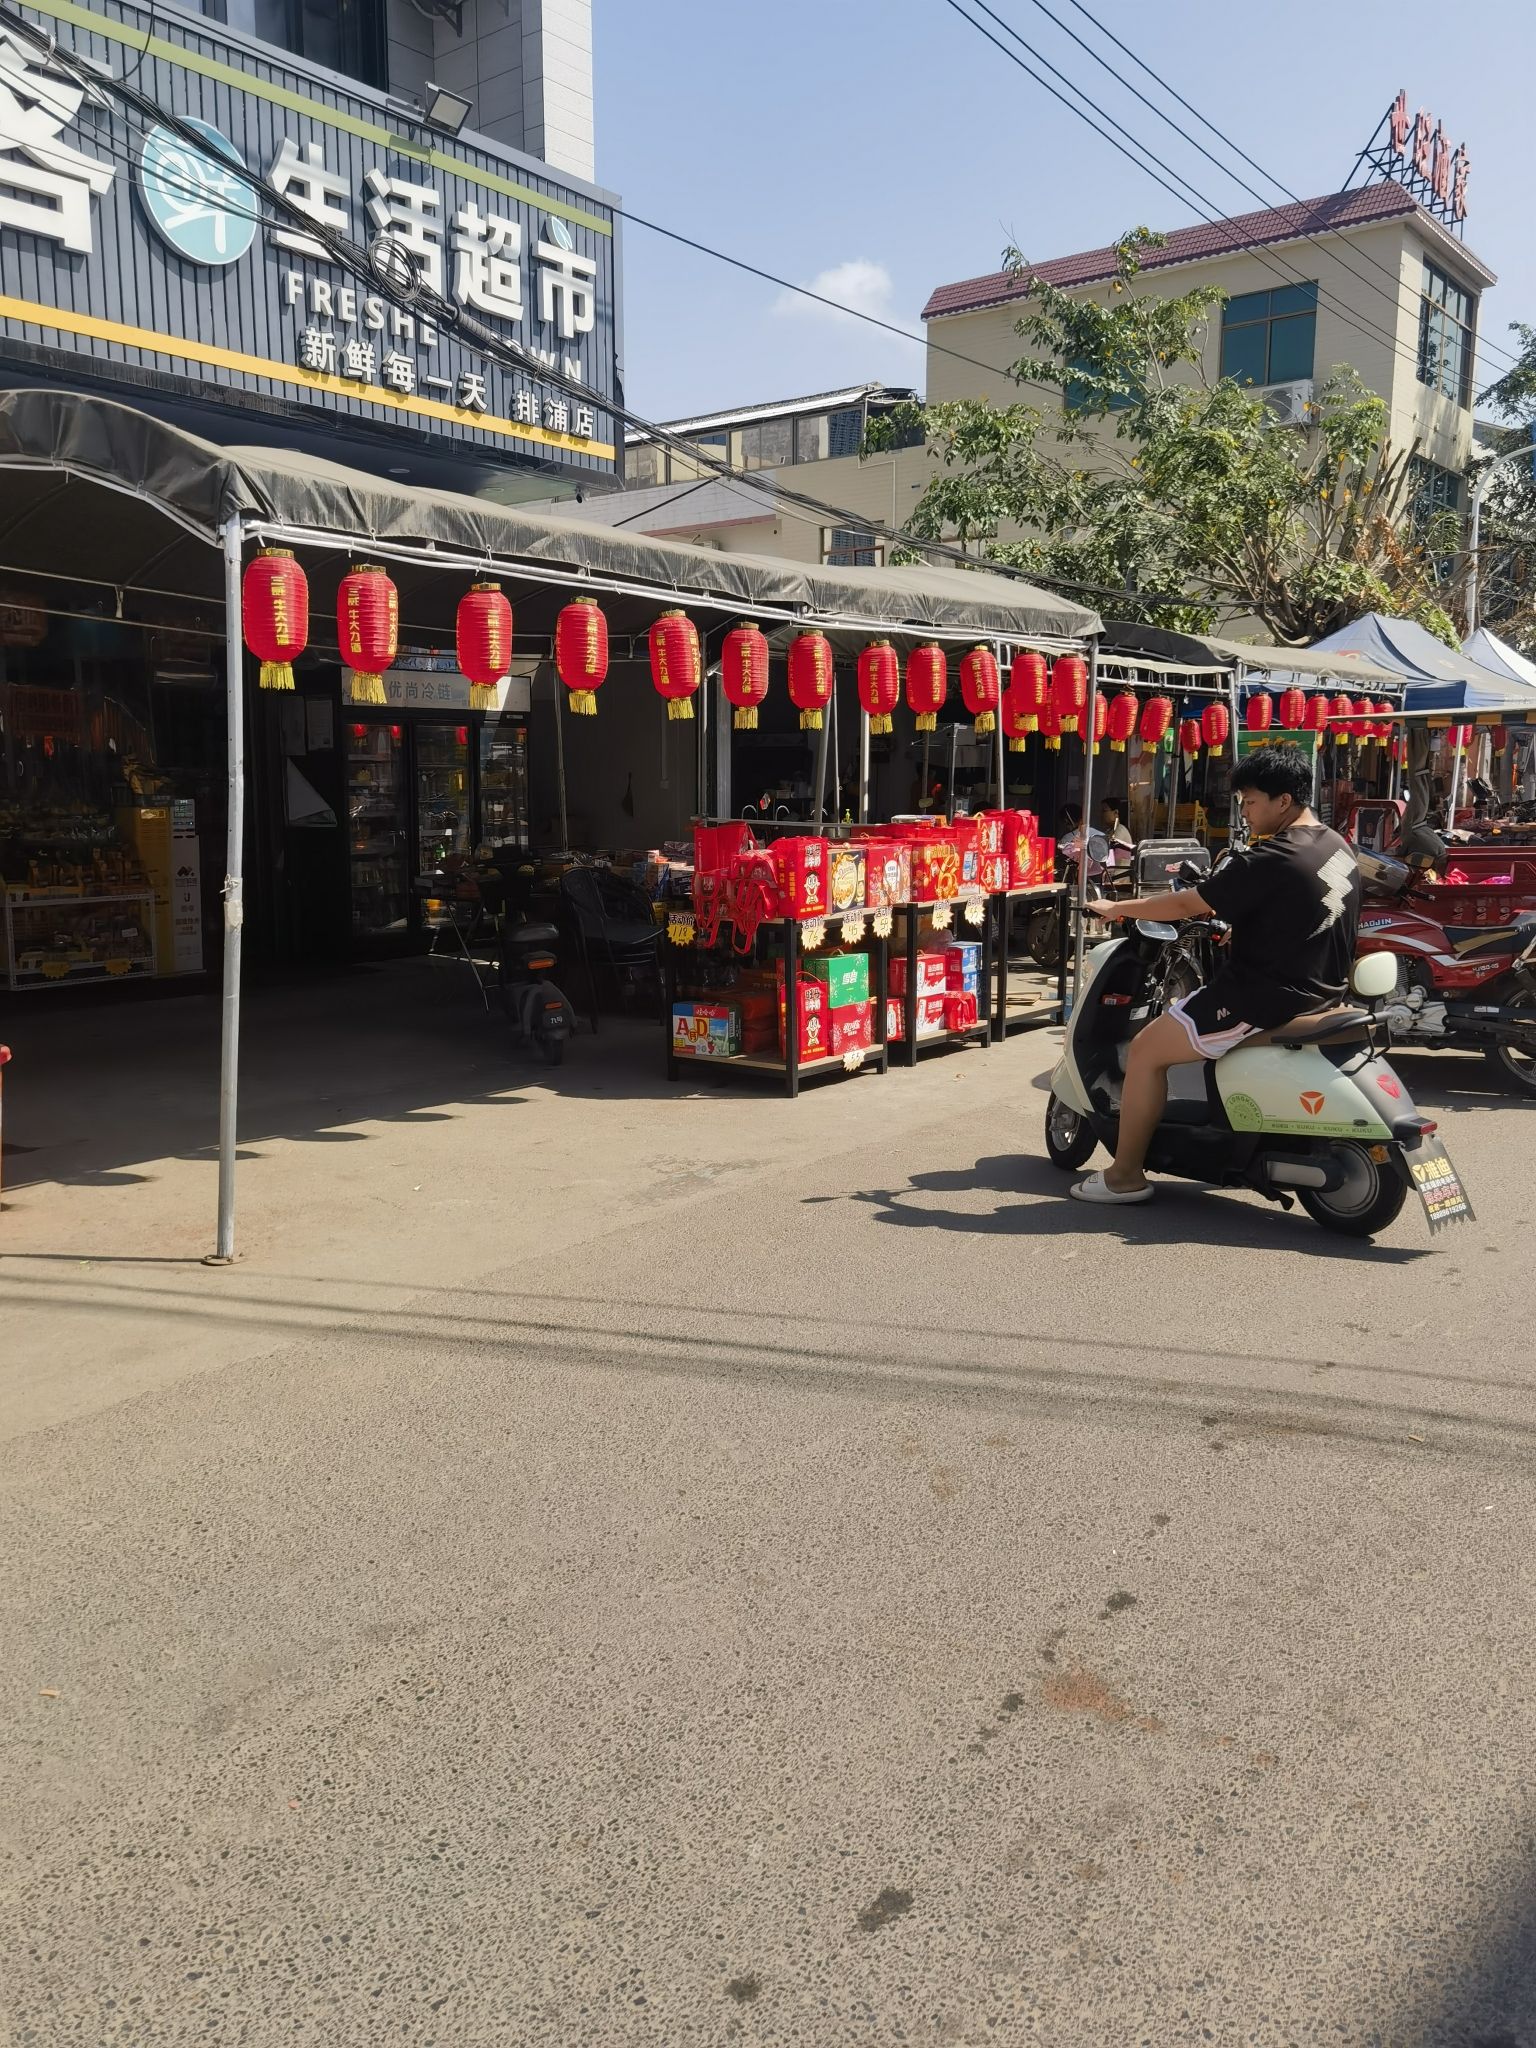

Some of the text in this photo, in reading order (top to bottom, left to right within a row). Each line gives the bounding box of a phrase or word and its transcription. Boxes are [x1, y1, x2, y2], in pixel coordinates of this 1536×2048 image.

[266, 136, 596, 340] 生活超市
[301, 326, 596, 440] 新鲜每一天 排浦店
[388, 679, 451, 701] 优尚冷链
[1423, 1157, 1453, 1180] 雅迪
